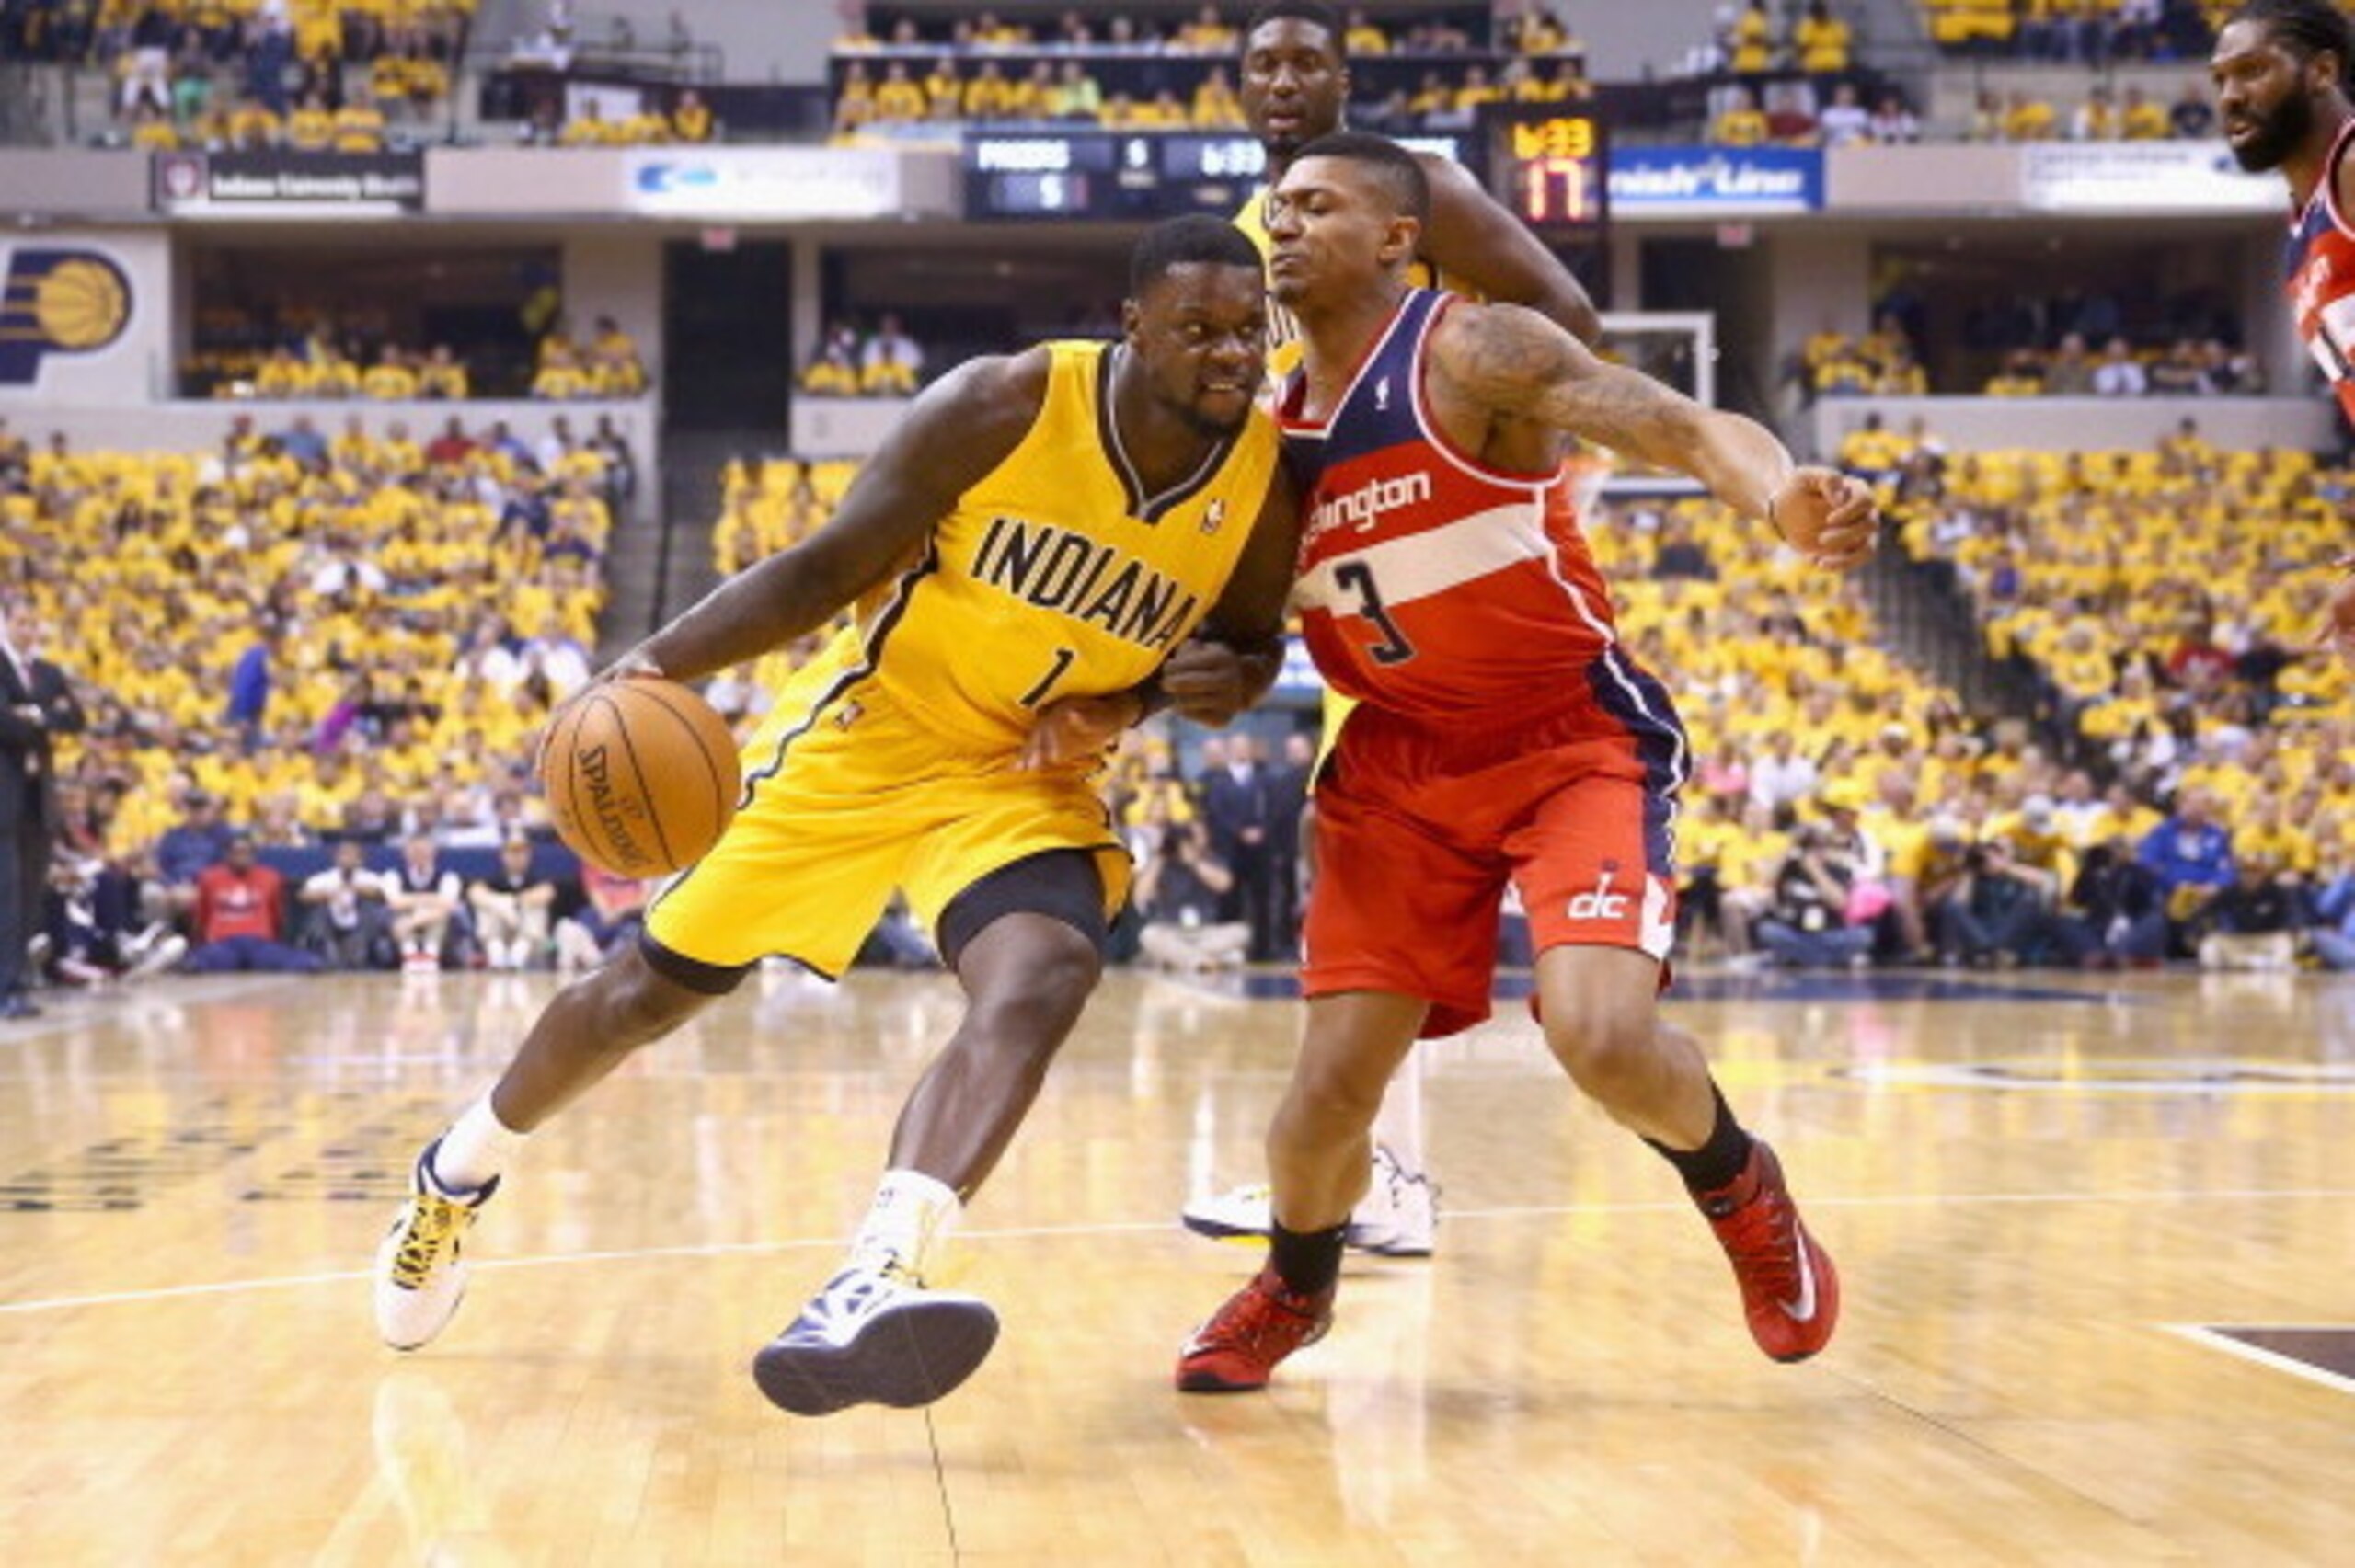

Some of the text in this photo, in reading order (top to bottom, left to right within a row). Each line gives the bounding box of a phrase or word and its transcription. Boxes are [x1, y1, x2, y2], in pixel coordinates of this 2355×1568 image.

[1530, 158, 1582, 220] 17
[971, 518, 1197, 647] INDIANA
[1335, 559, 1413, 665] 3
[1018, 647, 1074, 708] 1
[579, 743, 653, 870] SPALDING
